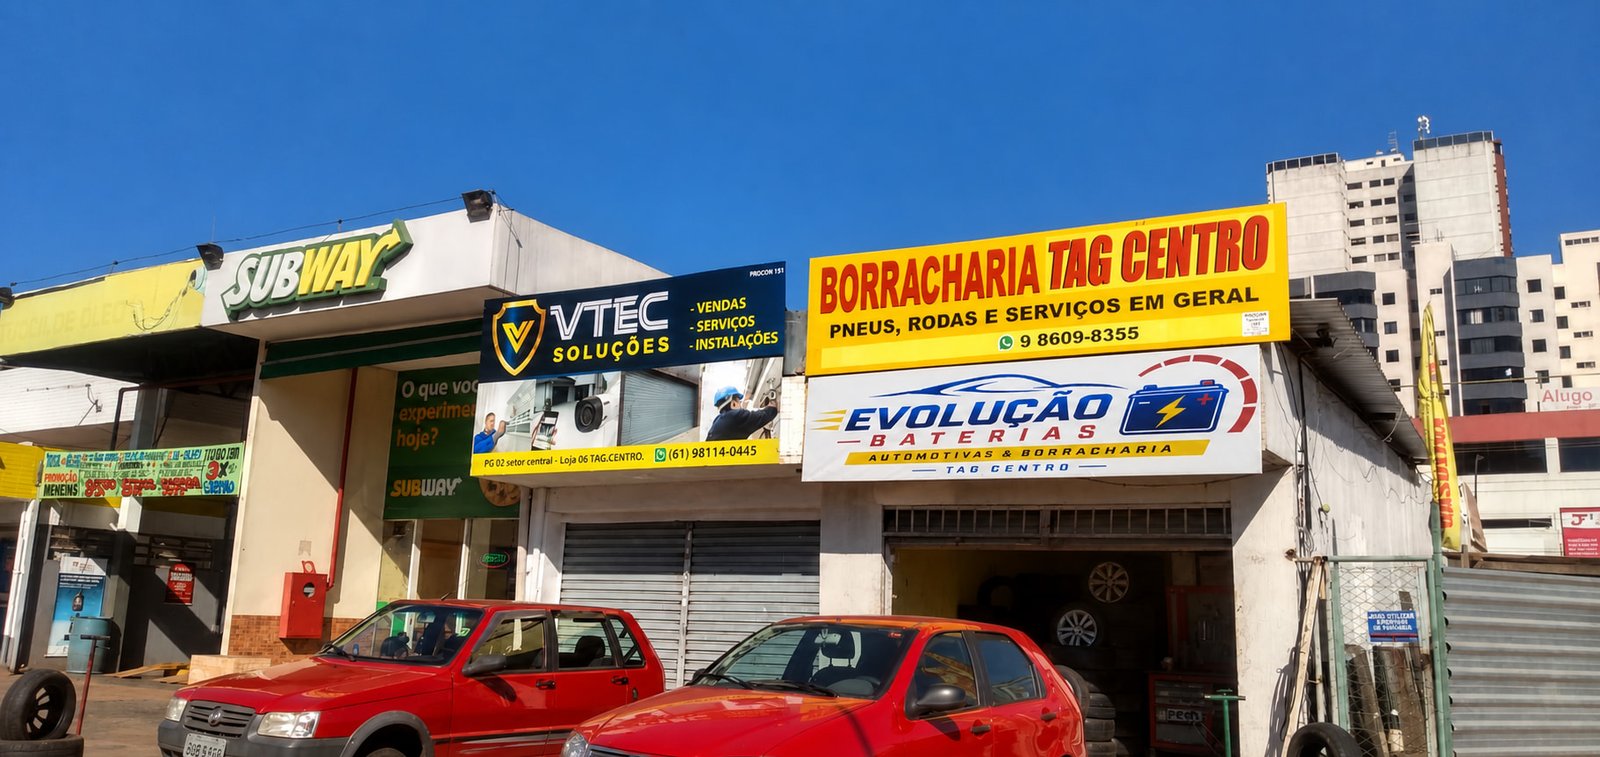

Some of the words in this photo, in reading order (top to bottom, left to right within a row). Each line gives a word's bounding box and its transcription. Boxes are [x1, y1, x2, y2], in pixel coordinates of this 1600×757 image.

[222, 227, 401, 308] SUBWAY
[819, 244, 1040, 315] BORRACHARIA
[1049, 234, 1113, 290] TAG
[1120, 214, 1270, 283] CENTRO
[550, 290, 669, 341] VTEC
[697, 297, 747, 314] VENDAS
[830, 319, 901, 338] PNEUS,
[908, 311, 977, 332] RODAS
[985, 309, 998, 324] E
[1006, 297, 1121, 322] SERVIÇOS
[1129, 294, 1164, 312] EM
[1173, 287, 1260, 307] GERAL
[697, 315, 756, 332] SERVIÇOS
[696, 331, 779, 351] INSTALAÇÕES
[1020, 334, 1031, 348] 9
[1037, 326, 1140, 347] 8609-8355
[553, 336, 670, 363] SOLUÇÕES
[402, 380, 414, 398] O
[418, 381, 448, 401] que
[452, 379, 480, 394] voc
[1542, 389, 1593, 405] Alugo
[400, 402, 476, 424] experime
[844, 389, 1113, 432] EVOLUÇÃO
[396, 427, 439, 451] hoje?
[869, 424, 1096, 447] BATERIAS
[484, 459, 495, 468] PG
[495, 458, 505, 467] 02
[506, 458, 525, 467] setor
[526, 456, 553, 466] central
[560, 455, 577, 467] Loja
[578, 454, 589, 464] 06
[589, 452, 645, 464] TAG.CENTRO.
[668, 449, 690, 461] (61)
[691, 445, 757, 459] 98114-0445
[868, 450, 994, 462] AUTOMOTIVAS
[1002, 450, 1012, 458] &
[1021, 444, 1172, 457] BORRACHARIA
[946, 465, 979, 474] TAG
[991, 463, 1069, 473] CENTRO
[390, 477, 462, 497] SUBWAY
